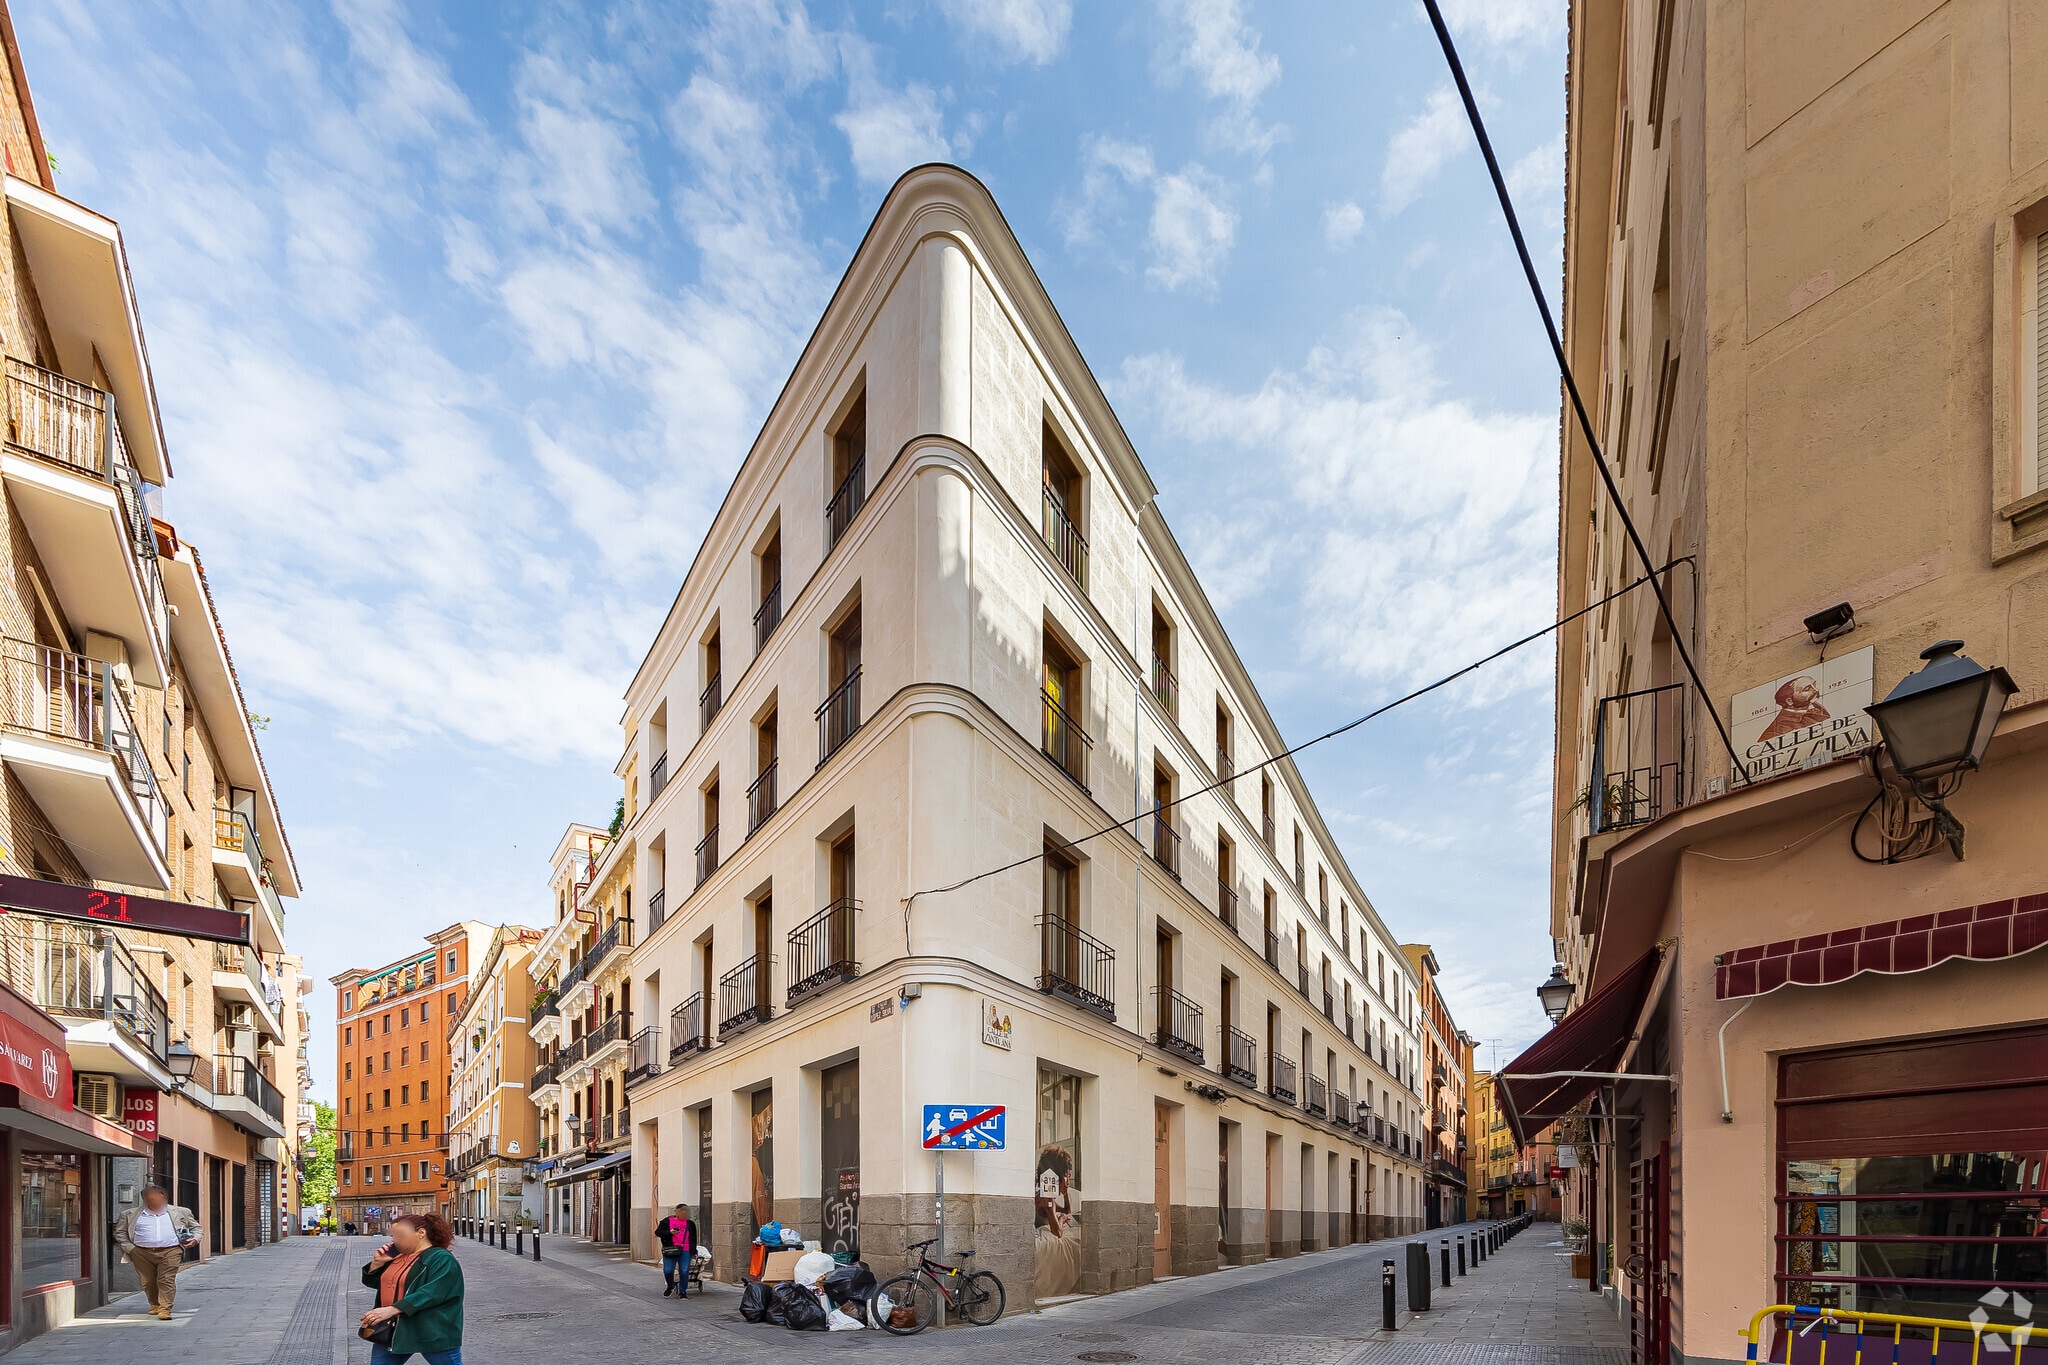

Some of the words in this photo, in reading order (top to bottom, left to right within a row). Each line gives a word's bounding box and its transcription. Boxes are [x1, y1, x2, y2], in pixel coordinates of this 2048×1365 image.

[1828, 679, 1848, 690] 1925
[1751, 706, 1768, 716] 1861
[1745, 723, 1825, 760] CALLE
[1831, 713, 1857, 731] DE
[1731, 747, 1801, 784] LOPEZ
[1809, 726, 1871, 757] SILVA
[87, 891, 133, 922] 21
[987, 1026, 1004, 1038] CALLE
[124, 1098, 154, 1112] LOS
